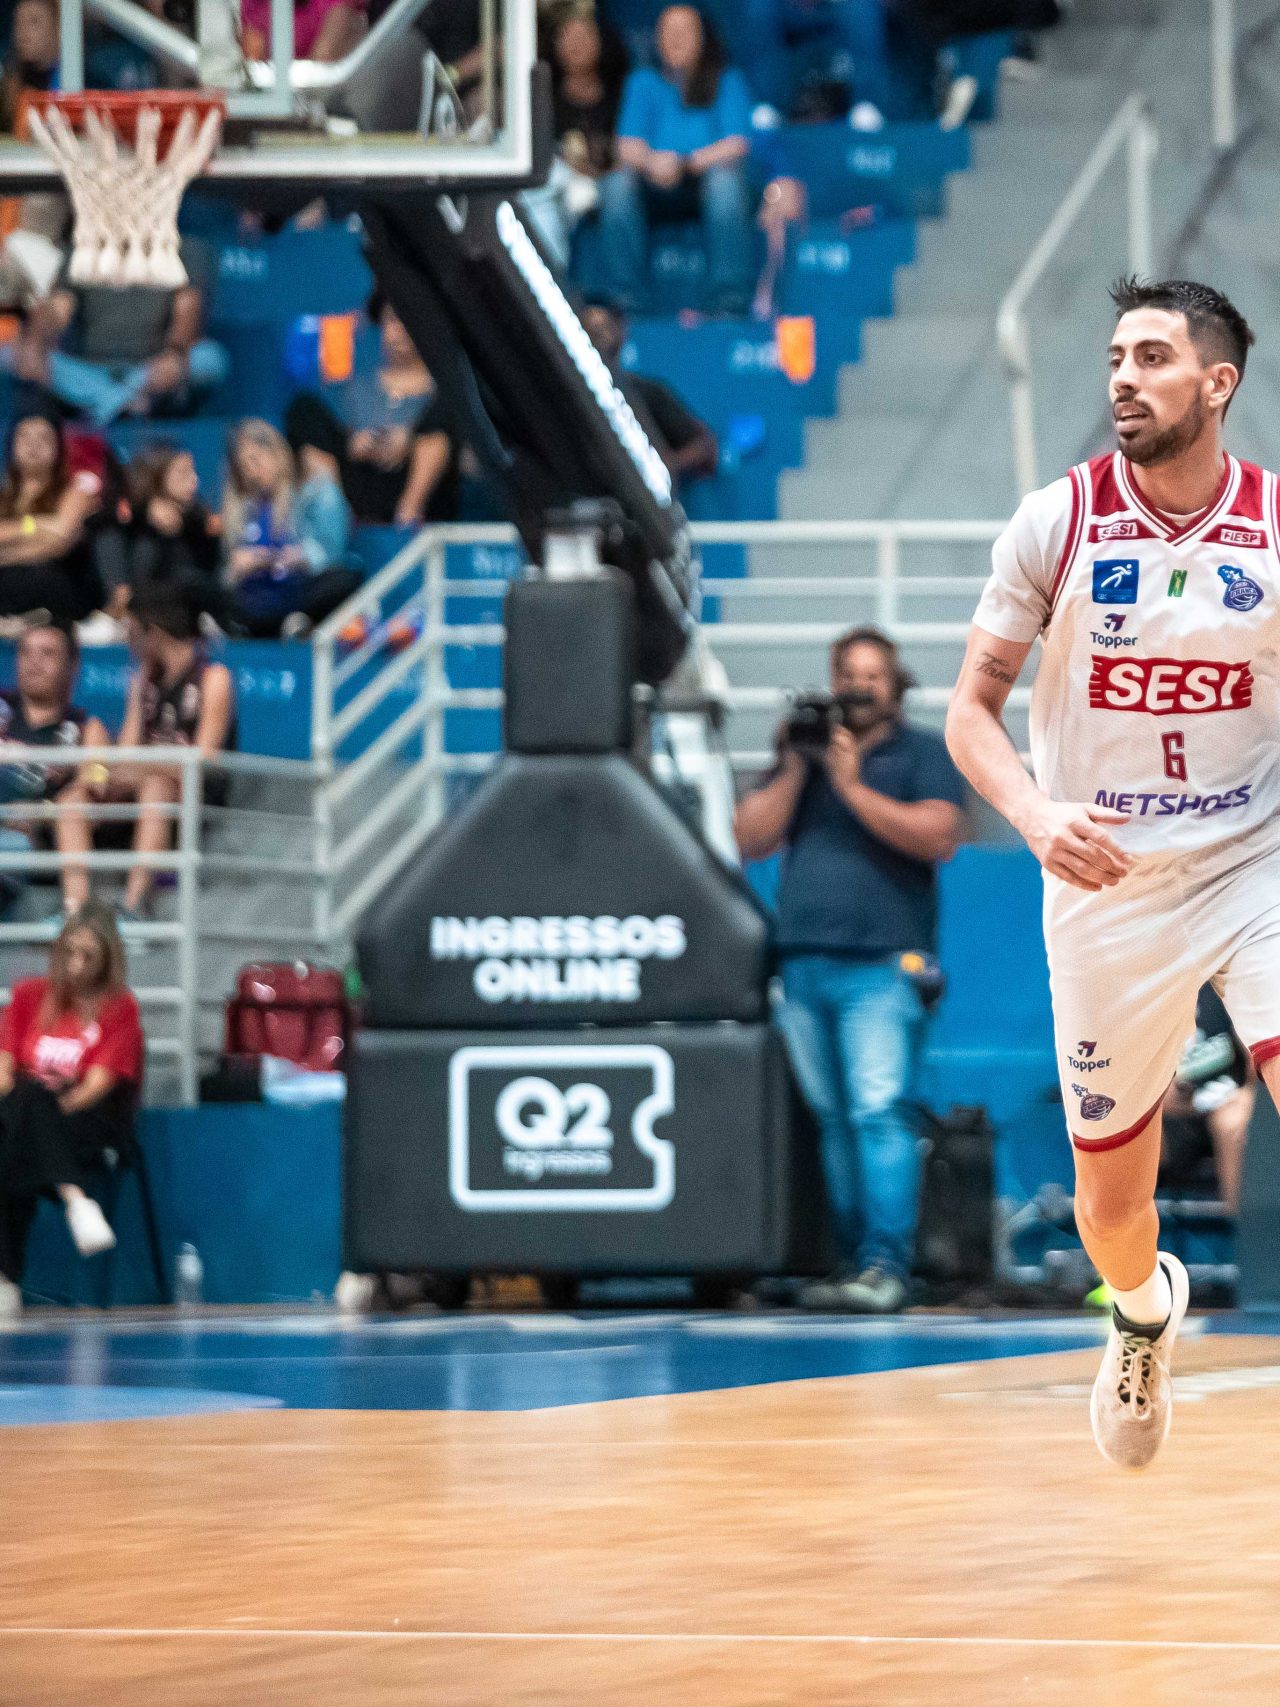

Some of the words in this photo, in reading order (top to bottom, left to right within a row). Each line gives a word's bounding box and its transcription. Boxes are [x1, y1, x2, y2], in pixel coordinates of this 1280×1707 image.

[1223, 531, 1259, 543] FIESP
[1089, 630, 1138, 649] Topper
[1104, 662, 1243, 712] SESI
[1160, 730, 1187, 782] 6
[1094, 784, 1252, 817] NETSHOES
[430, 914, 688, 960] INGRESSOS
[472, 958, 642, 1003] ONLINE
[1067, 1055, 1112, 1073] Topper
[495, 1075, 615, 1150] Q2
